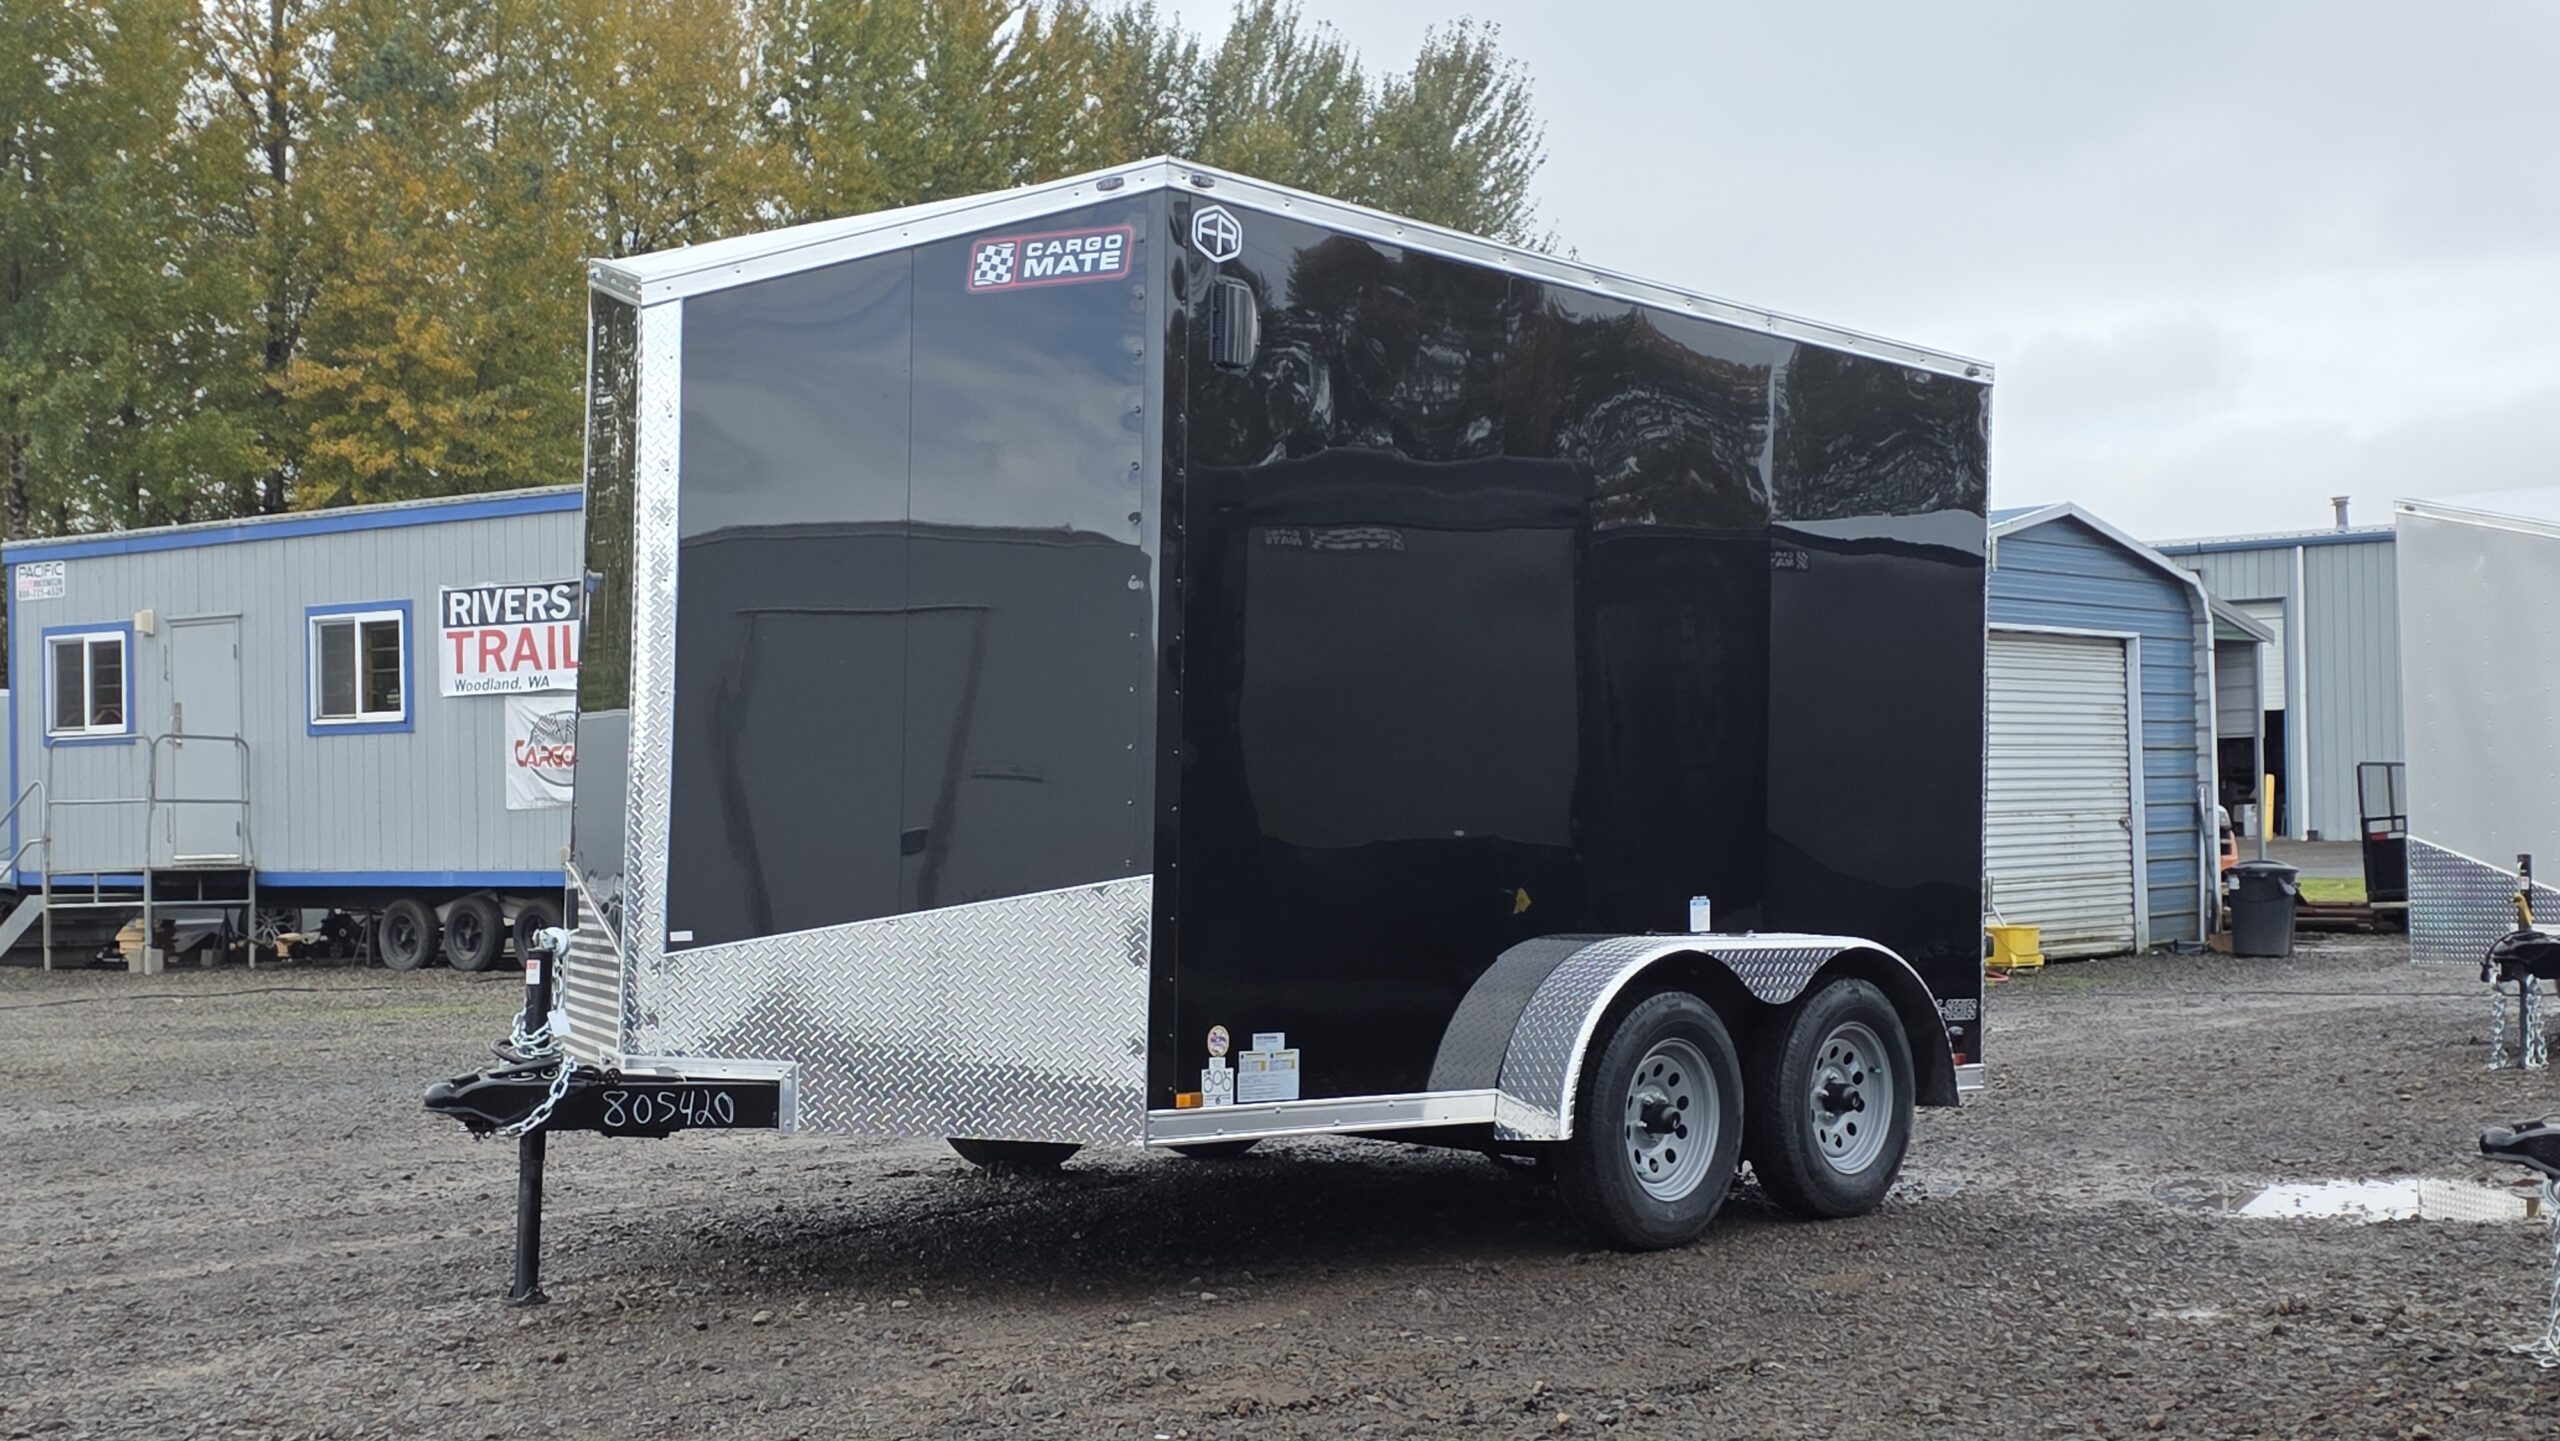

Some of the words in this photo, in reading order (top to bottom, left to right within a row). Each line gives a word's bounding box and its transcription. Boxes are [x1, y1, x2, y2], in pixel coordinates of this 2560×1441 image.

[1026, 234, 1123, 257] CARGO
[1023, 250, 1121, 278] MATE
[18, 563, 63, 578] PACIFIC
[449, 584, 572, 626] RIVERS
[446, 624, 579, 675] TRAIL
[528, 674, 550, 689] WA
[514, 739, 576, 768] CARGO
[602, 1089, 735, 1127] 805420
